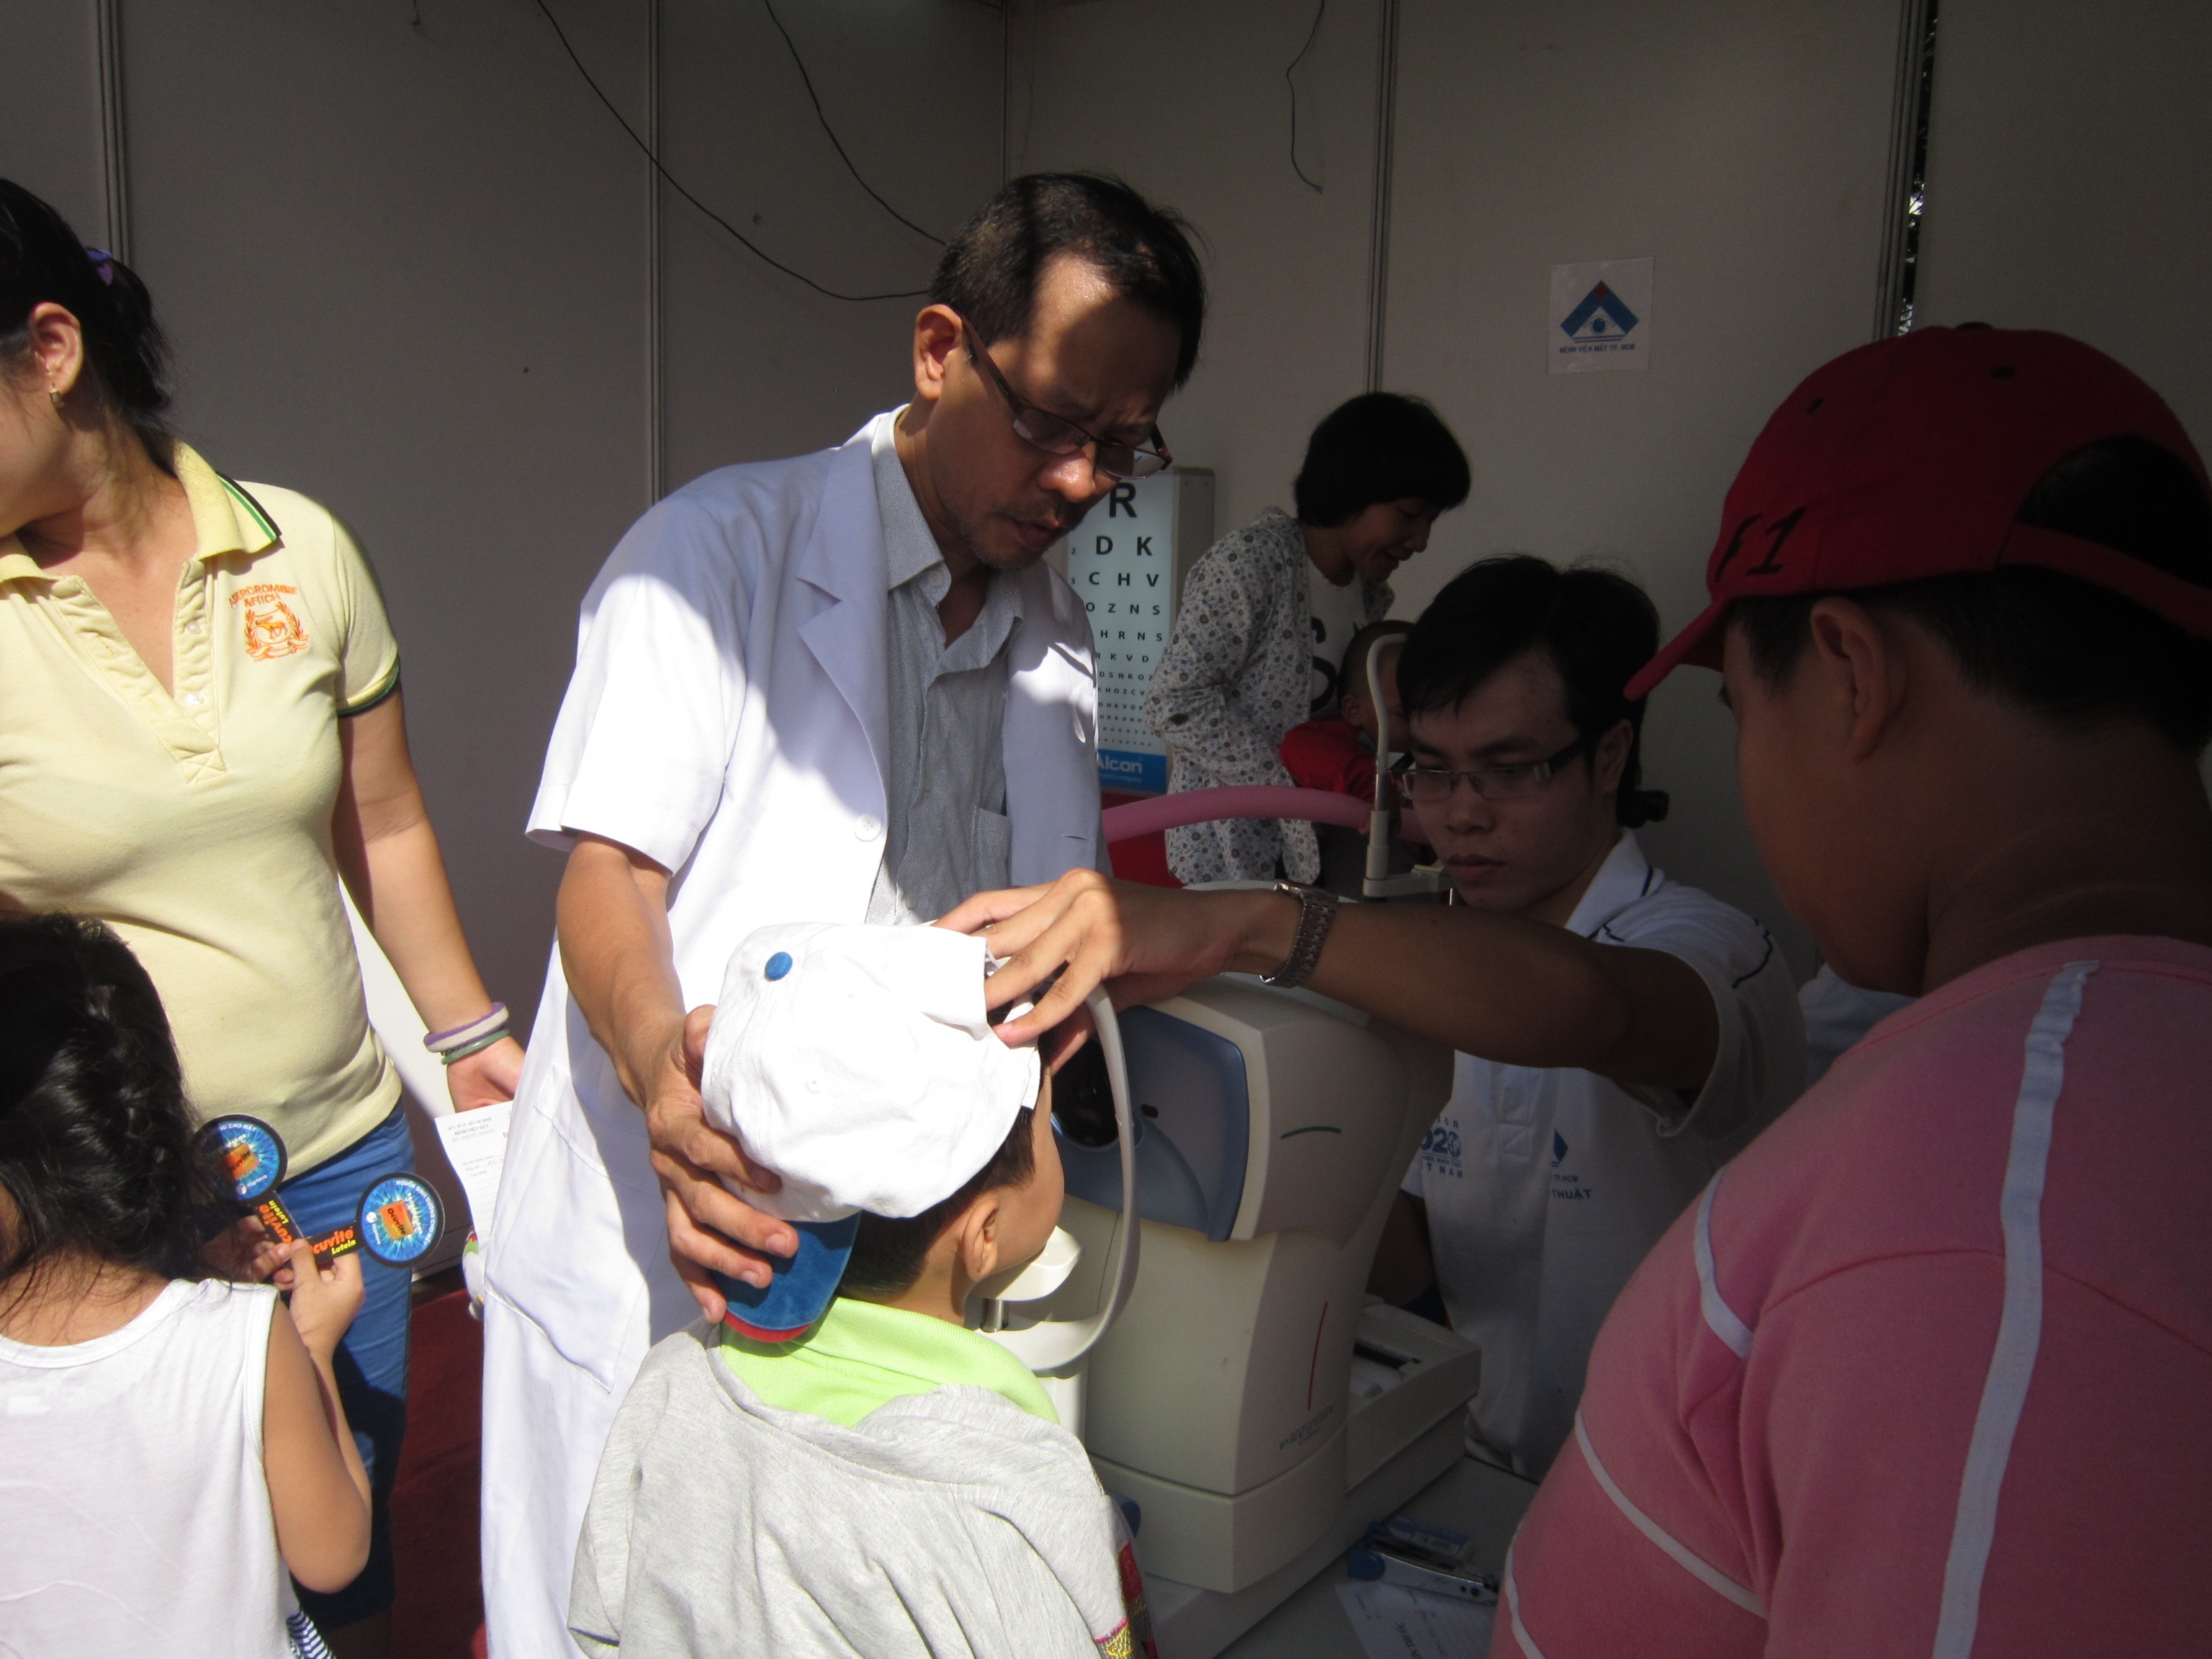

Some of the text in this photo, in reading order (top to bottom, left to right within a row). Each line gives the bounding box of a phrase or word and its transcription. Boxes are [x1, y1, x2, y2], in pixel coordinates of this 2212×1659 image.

[1109, 482, 1138, 518] R
[1096, 535, 1114, 555] D
[1136, 536, 1154, 557] K
[1421, 1127, 1462, 1159] 020
[258, 1204, 294, 1244] cuvite
[268, 1200, 290, 1225] Lutein
[311, 1229, 354, 1255] cuvite
[331, 1239, 357, 1256] Lutein
